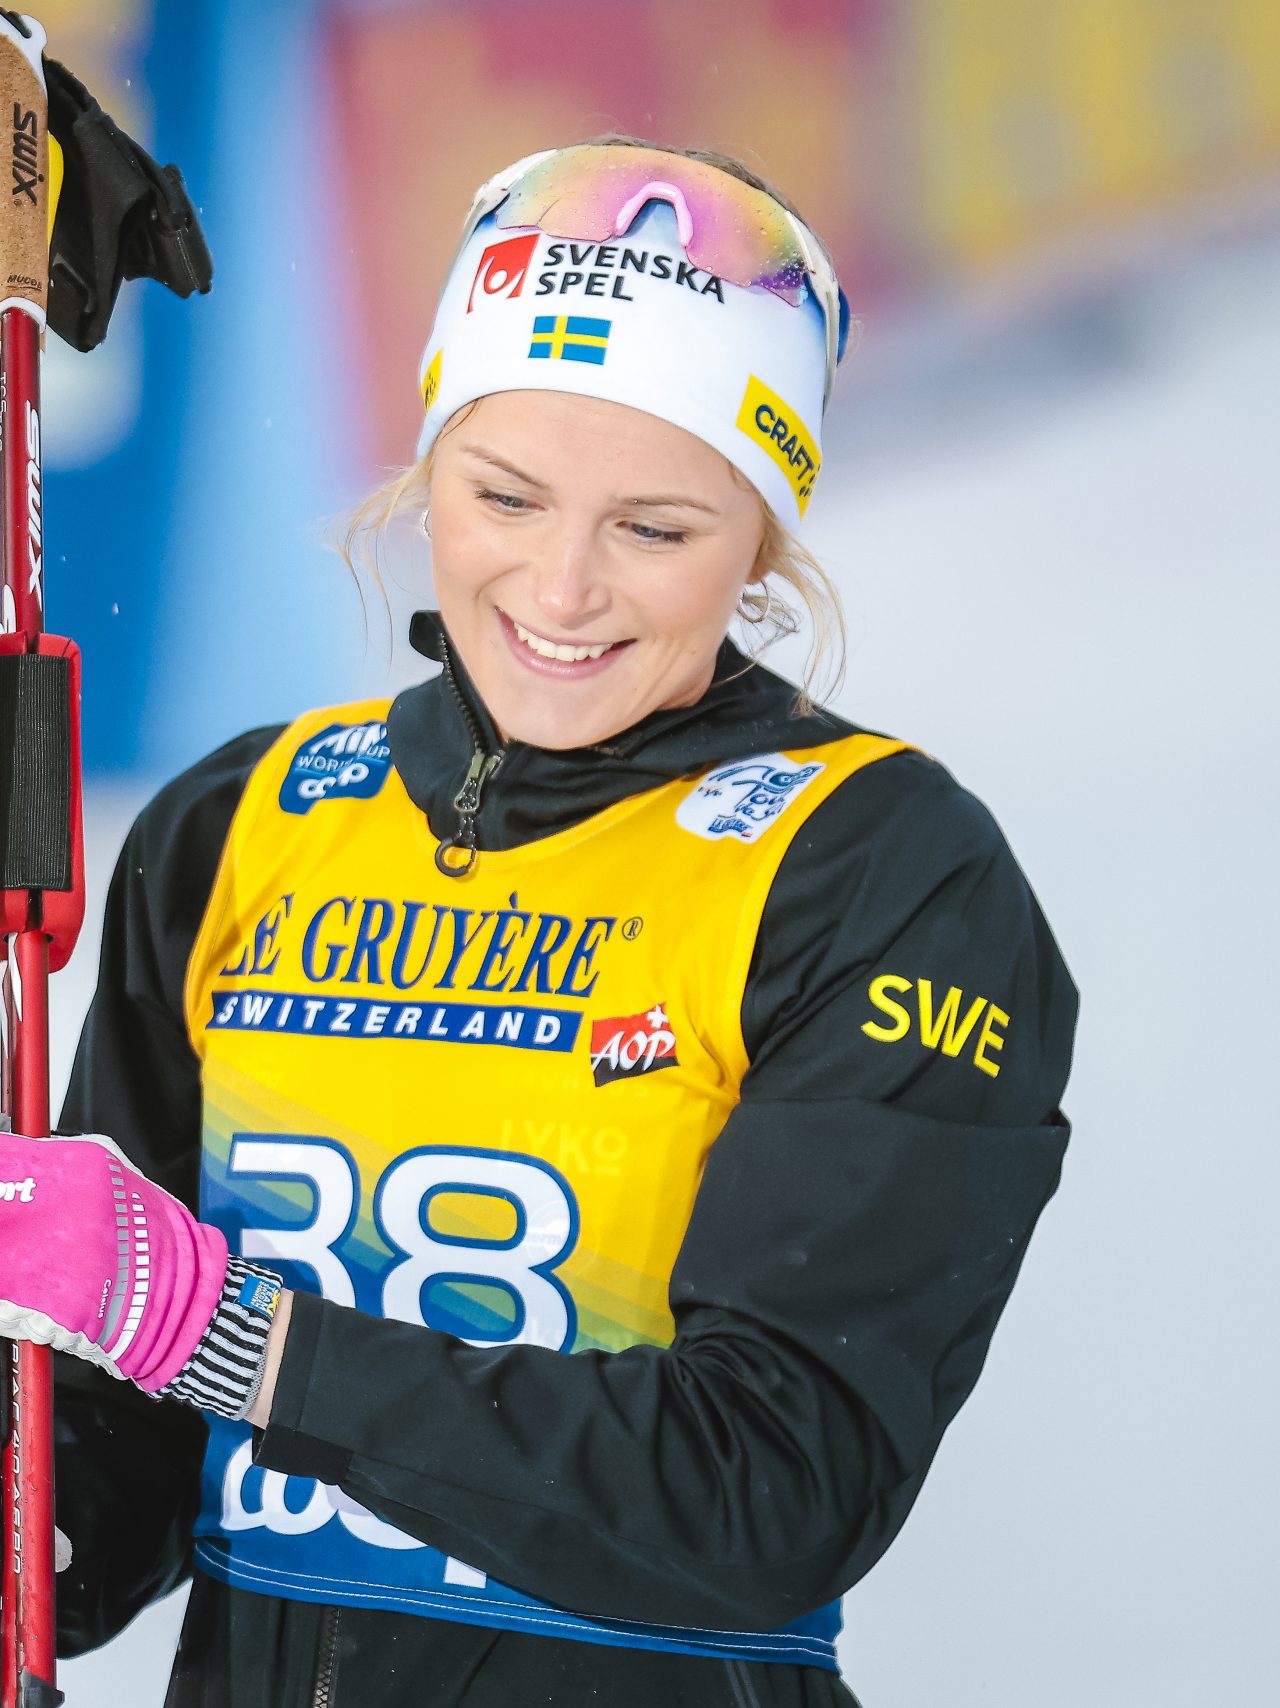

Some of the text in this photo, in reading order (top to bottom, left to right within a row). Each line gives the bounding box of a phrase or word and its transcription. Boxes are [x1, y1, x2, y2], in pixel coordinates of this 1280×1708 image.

[534, 271, 634, 302] SPEL
[543, 244, 725, 304] SVENSKA
[755, 404, 815, 481] CRAFT
[216, 994, 561, 1046] SWITZERLAND
[860, 974, 1011, 1079] SWE
[590, 1030, 676, 1072] AOP
[227, 1132, 581, 1354] 38
